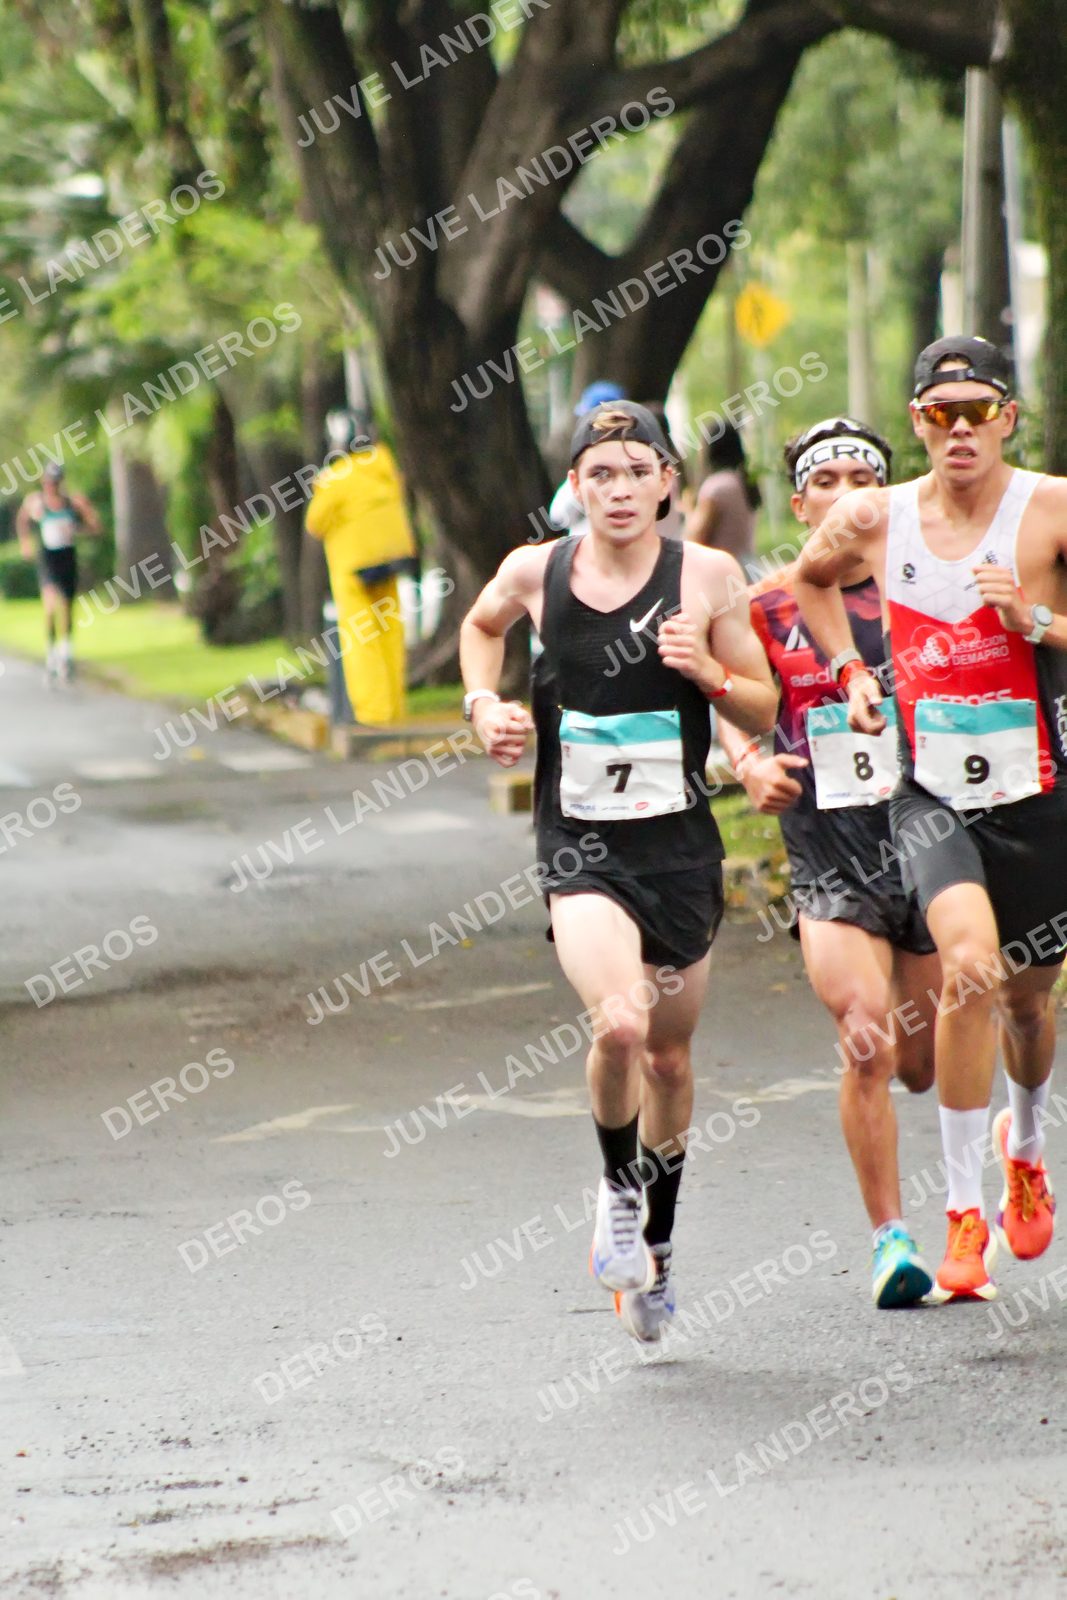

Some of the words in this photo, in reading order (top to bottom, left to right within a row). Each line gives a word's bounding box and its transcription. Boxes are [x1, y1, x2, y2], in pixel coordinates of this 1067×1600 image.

[952, 646, 1009, 665] DEMAPRO
[606, 763, 633, 793] 7
[853, 751, 875, 781] 8
[964, 754, 990, 785] 9
